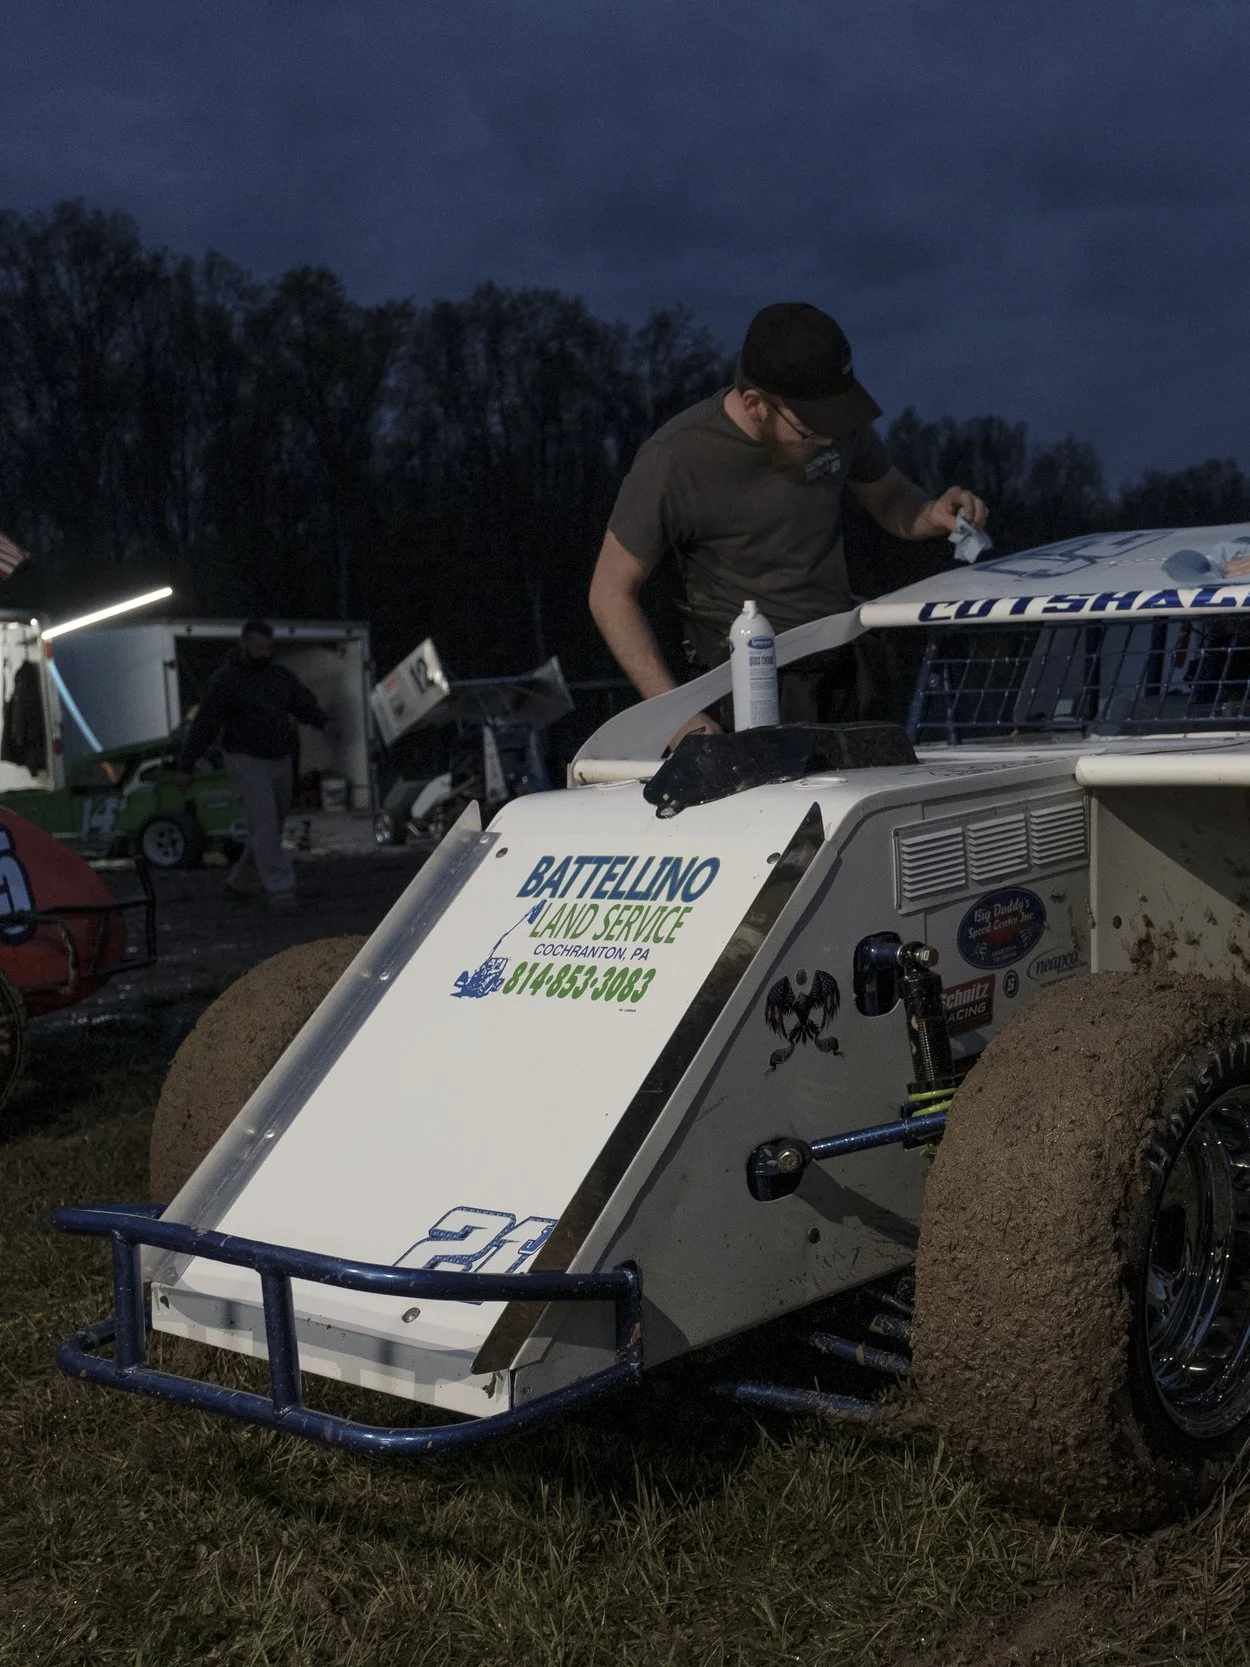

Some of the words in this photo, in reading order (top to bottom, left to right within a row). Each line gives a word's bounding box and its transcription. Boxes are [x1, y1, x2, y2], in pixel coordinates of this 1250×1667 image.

[517, 855, 721, 902] BATTELLINO
[529, 902, 600, 941] LAND
[592, 904, 693, 944] SERVICE
[533, 944, 626, 961] COCHRANTON,
[631, 948, 650, 961] PA
[946, 1002, 986, 1024] ACING
